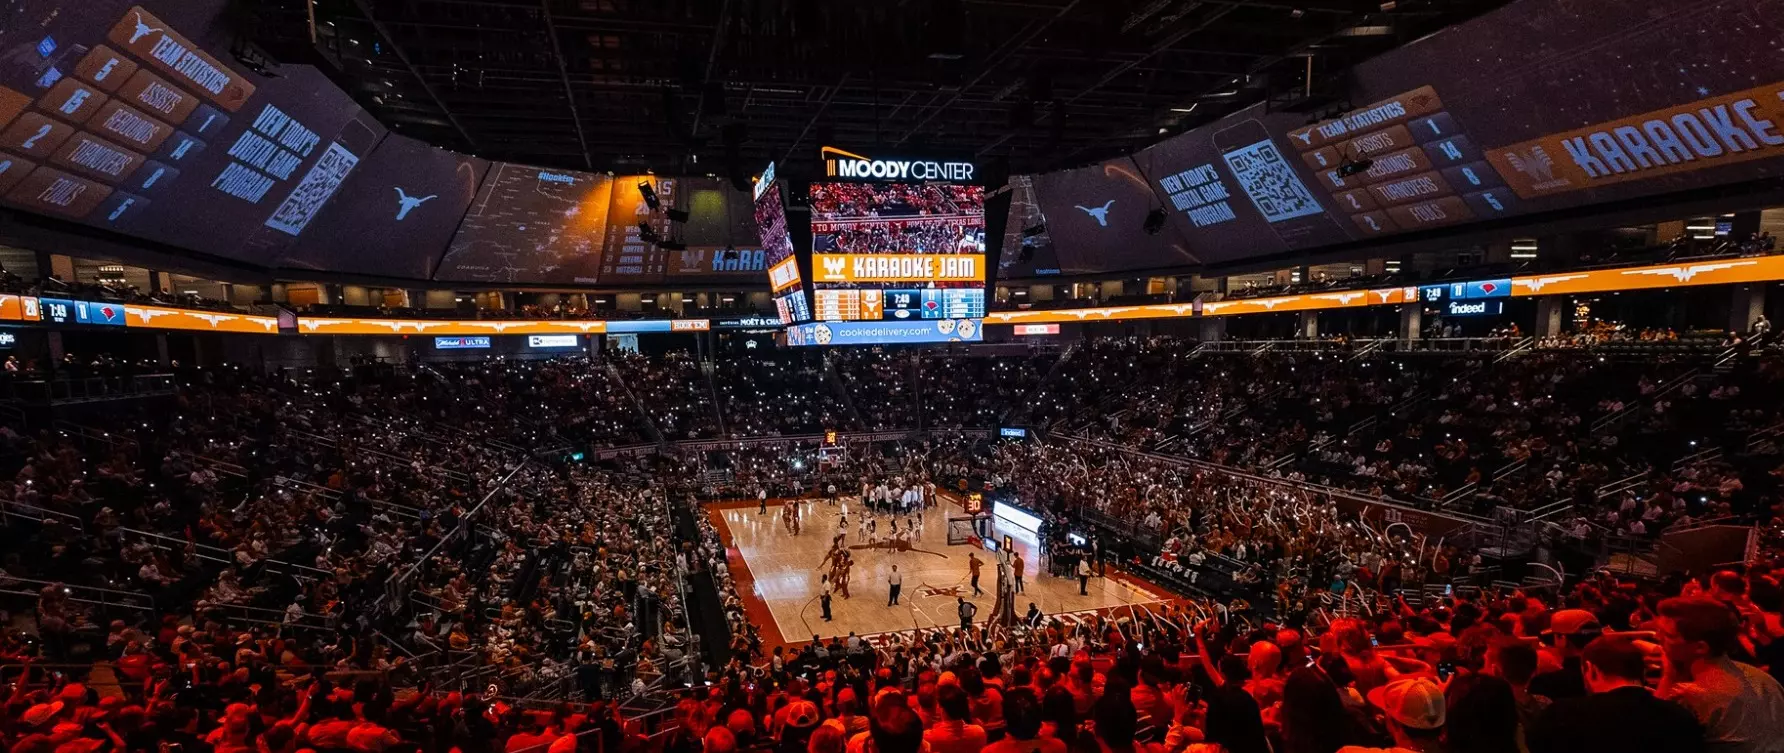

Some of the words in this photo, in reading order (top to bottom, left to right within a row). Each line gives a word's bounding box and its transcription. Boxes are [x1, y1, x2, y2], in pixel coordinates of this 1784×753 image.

[94, 58, 119, 81] 5
[150, 34, 187, 67] TEAM
[175, 50, 230, 95] STATISTICS
[138, 82, 182, 114] ASSISTS
[102, 108, 160, 144] REBOUNDS
[198, 114, 216, 132] 1
[252, 103, 291, 138] VIEW
[278, 119, 320, 157] TODAY'S
[1316, 120, 1347, 139] TEAM
[1344, 101, 1406, 131] STATISTICS
[1427, 119, 1440, 134] 1
[22, 124, 52, 148] 2
[1353, 132, 1394, 153] ASSISTS
[1561, 99, 1784, 178] KARAOKE
[67, 139, 132, 176] TURNOVERS
[227, 130, 278, 170] DIGITAL
[266, 149, 302, 180] GAME
[1439, 141, 1463, 160] 14
[839, 160, 910, 177] MOODY
[911, 161, 973, 180] CENTER
[1159, 175, 1184, 194] VIEW
[1179, 164, 1219, 188] TODAY'S
[37, 178, 87, 206] FOULS
[211, 162, 275, 204] PROGRAM
[1377, 176, 1438, 201] TURNOVERS
[1170, 188, 1206, 212] DIGITAL
[1199, 180, 1231, 202] GAME
[1346, 194, 1361, 210] 2
[1188, 201, 1236, 227] PROGRAM
[1409, 203, 1446, 222] FOULS
[830, 223, 857, 231] MOODY
[853, 257, 935, 278] KARAOKE
[939, 257, 974, 278] JAM
[1426, 288, 1441, 298] 7:49
[1455, 285, 1462, 296] 11
[50, 304, 67, 318] 7:49
[79, 304, 87, 319] 11
[1450, 302, 1485, 314] indeed
[968, 500, 980, 510] 30
